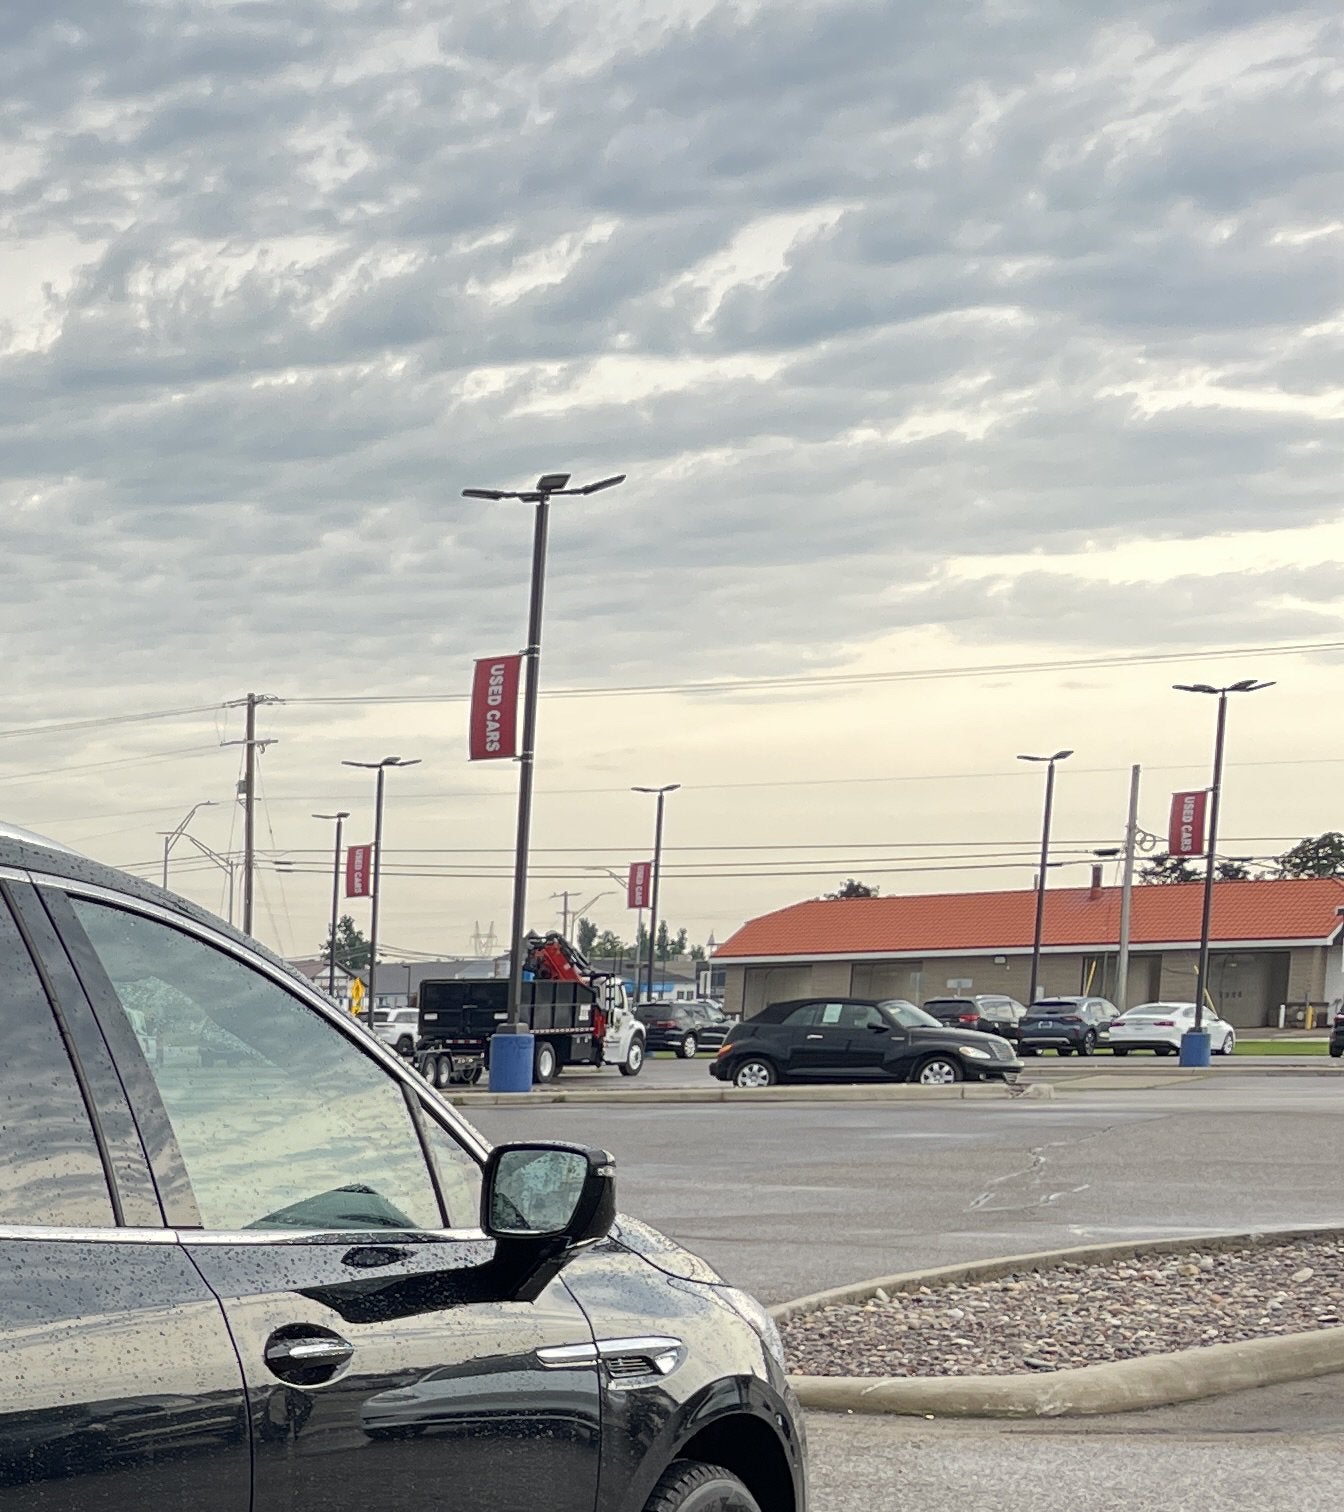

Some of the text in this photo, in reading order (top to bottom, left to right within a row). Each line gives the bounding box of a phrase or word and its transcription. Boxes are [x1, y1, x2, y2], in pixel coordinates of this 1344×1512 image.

[485, 663, 505, 753] USED CARS
[1180, 796, 1196, 852] USED CARS
